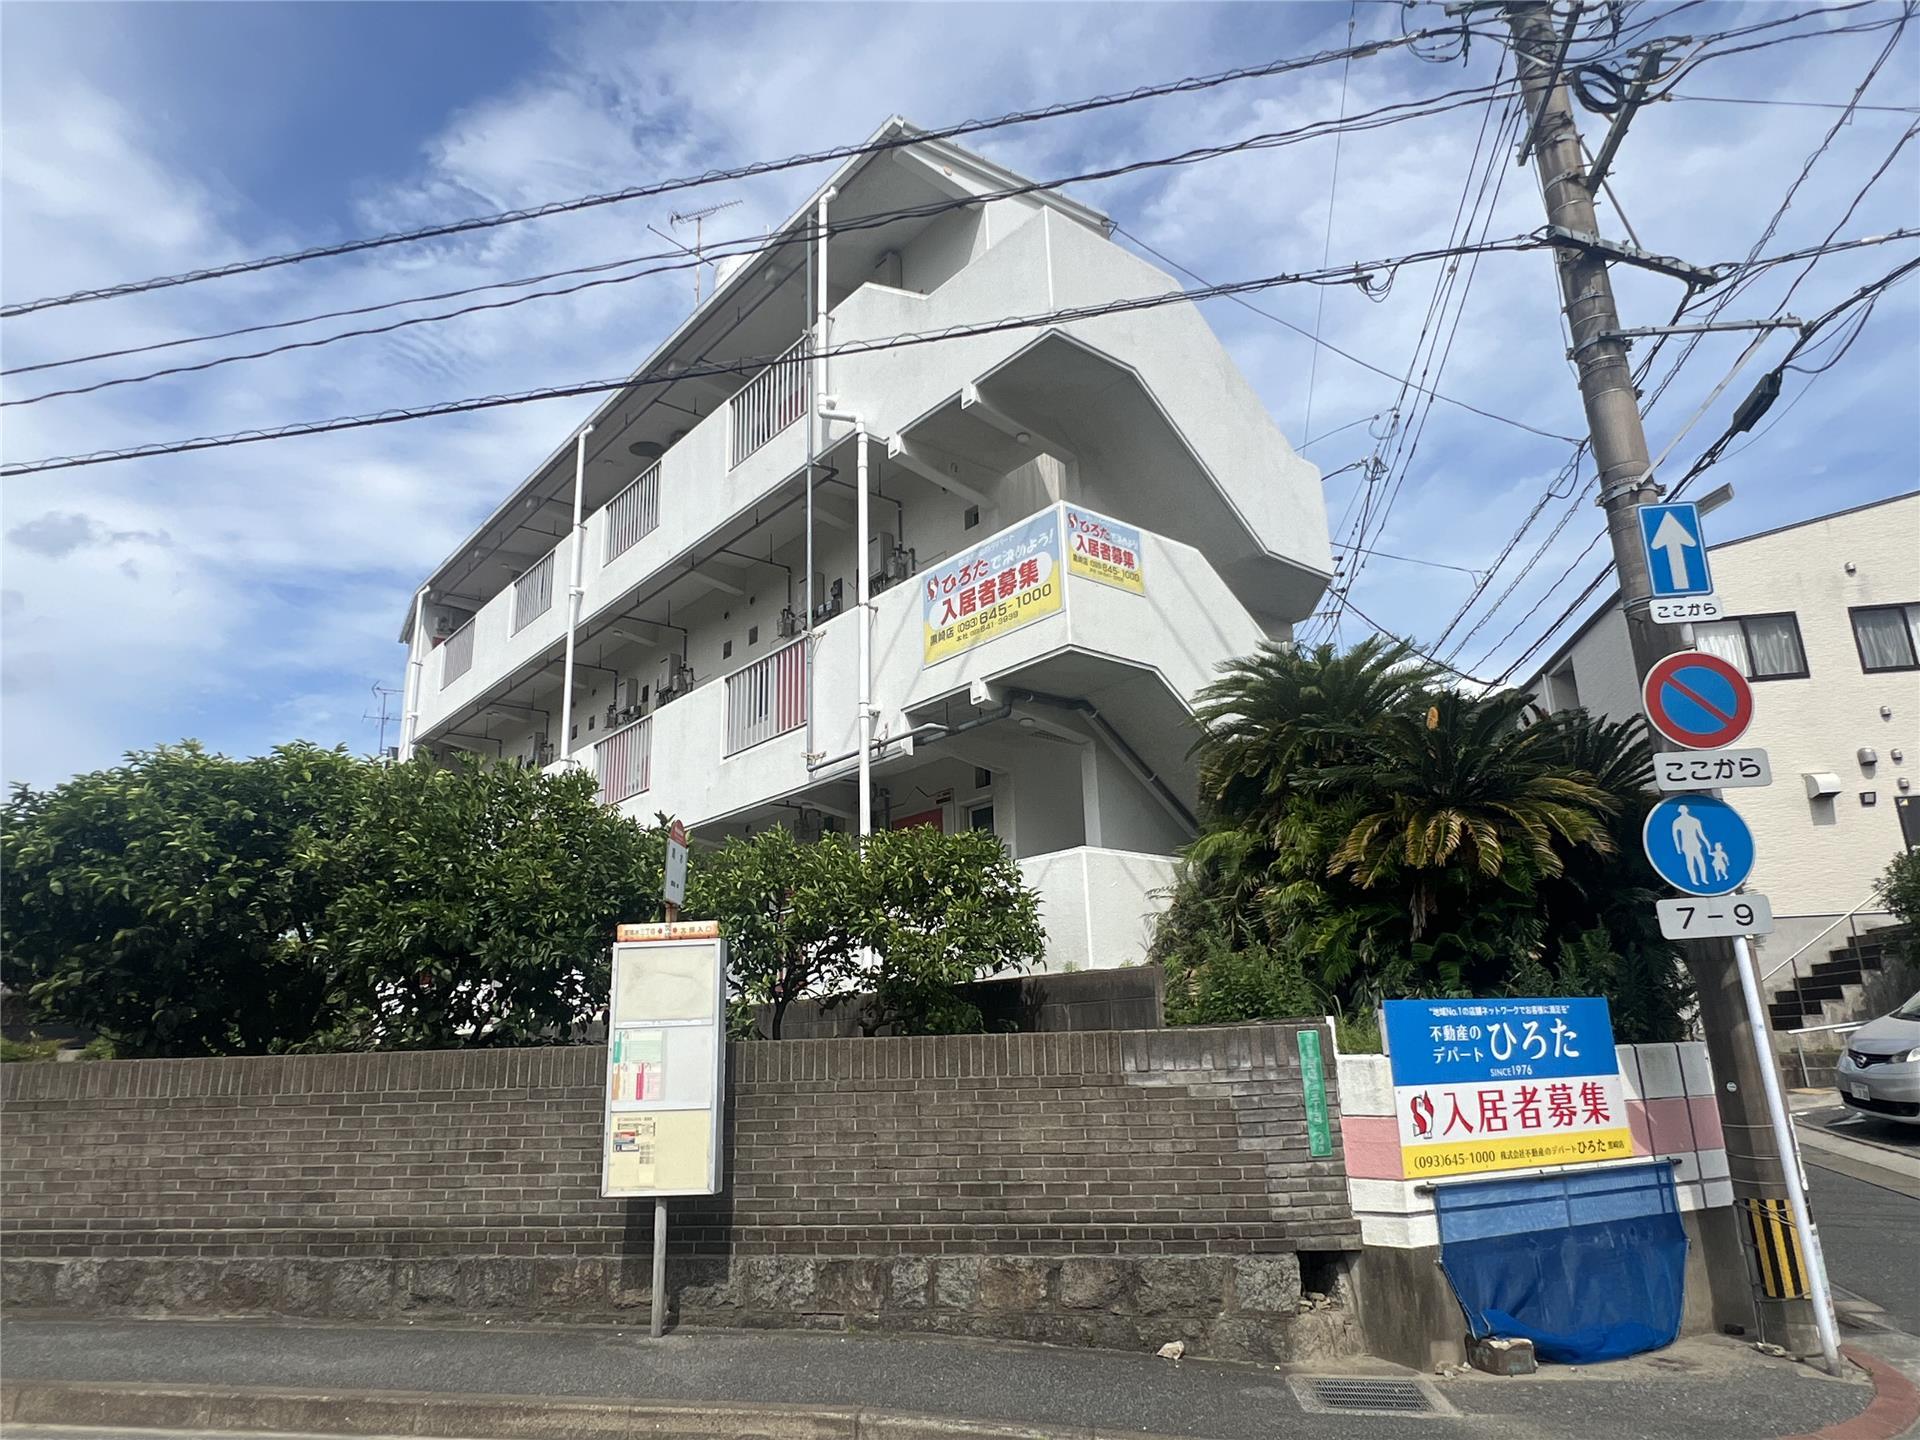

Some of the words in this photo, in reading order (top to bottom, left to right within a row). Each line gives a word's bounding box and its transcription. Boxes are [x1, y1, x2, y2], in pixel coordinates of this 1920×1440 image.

[1076, 534, 1135, 570] 入居者募集
[942, 559, 990, 593] ひろた
[940, 558, 1040, 626] 入居者募集
[1656, 602, 1718, 618] ここから
[1665, 757, 1762, 781] ここから
[1429, 1024, 1482, 1042] 不動産の
[1486, 1018, 1580, 1061] ひろた
[1432, 1047, 1484, 1064] デパート
[1442, 1082, 1610, 1136] 入居者募集
[1414, 1150, 1496, 1170] (093)645-1000
